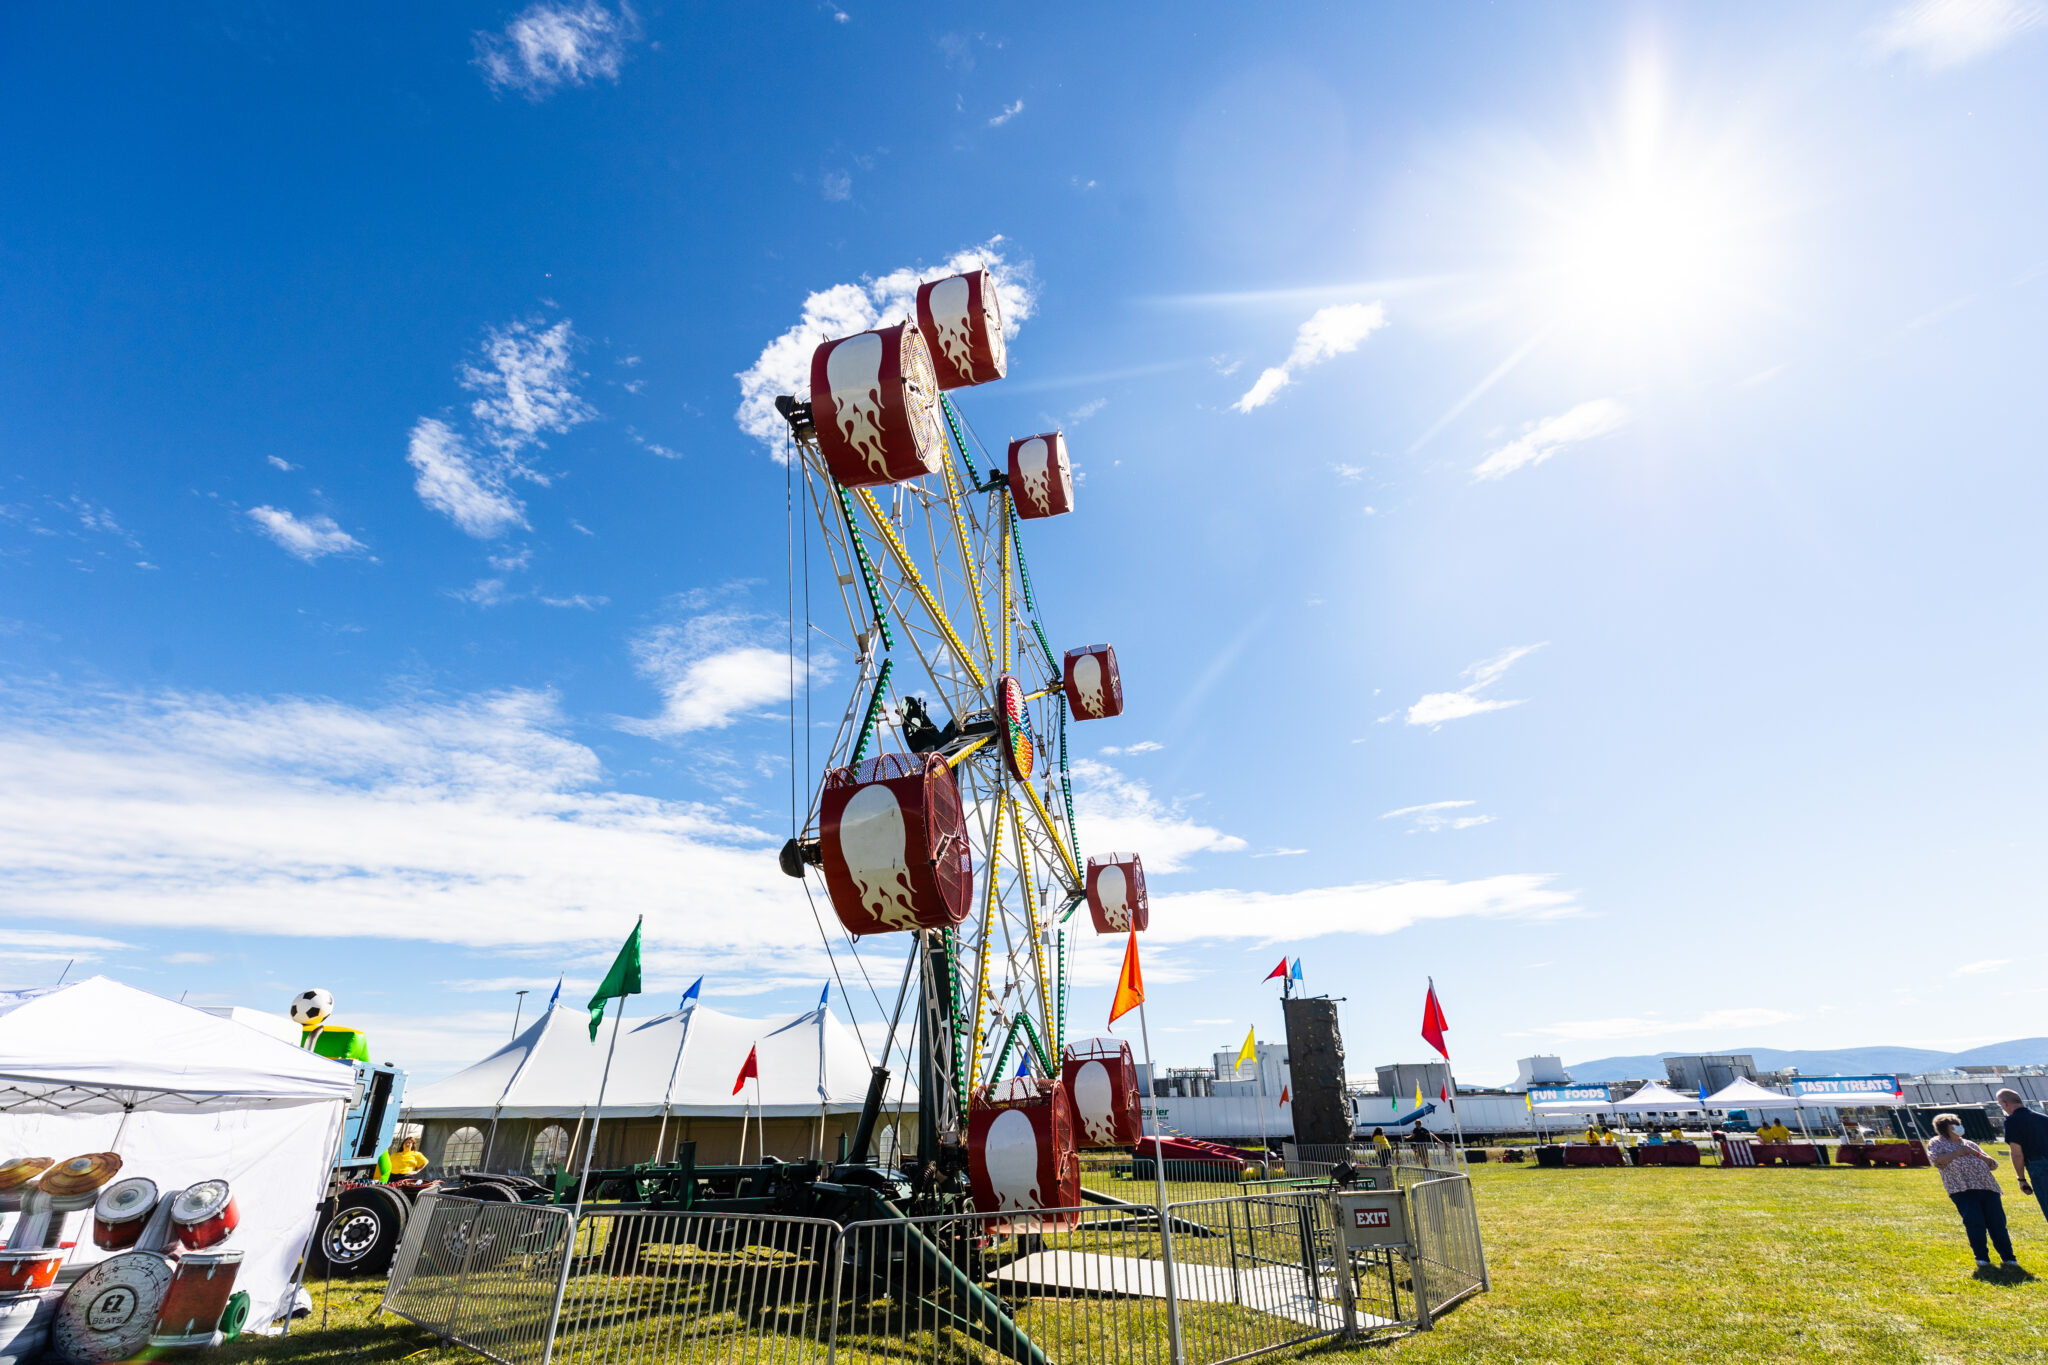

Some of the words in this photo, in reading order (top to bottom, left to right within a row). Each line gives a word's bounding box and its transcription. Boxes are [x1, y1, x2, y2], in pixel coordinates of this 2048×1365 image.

[1799, 1081, 1839, 1092] TASTY
[1841, 1079, 1893, 1091] TREATS
[1532, 1090, 1557, 1100] FUN
[1564, 1087, 1605, 1099] FOODS
[1356, 1212, 1387, 1225] EXIT
[101, 1294, 125, 1313] EZ
[92, 1316, 123, 1325] BEATS
